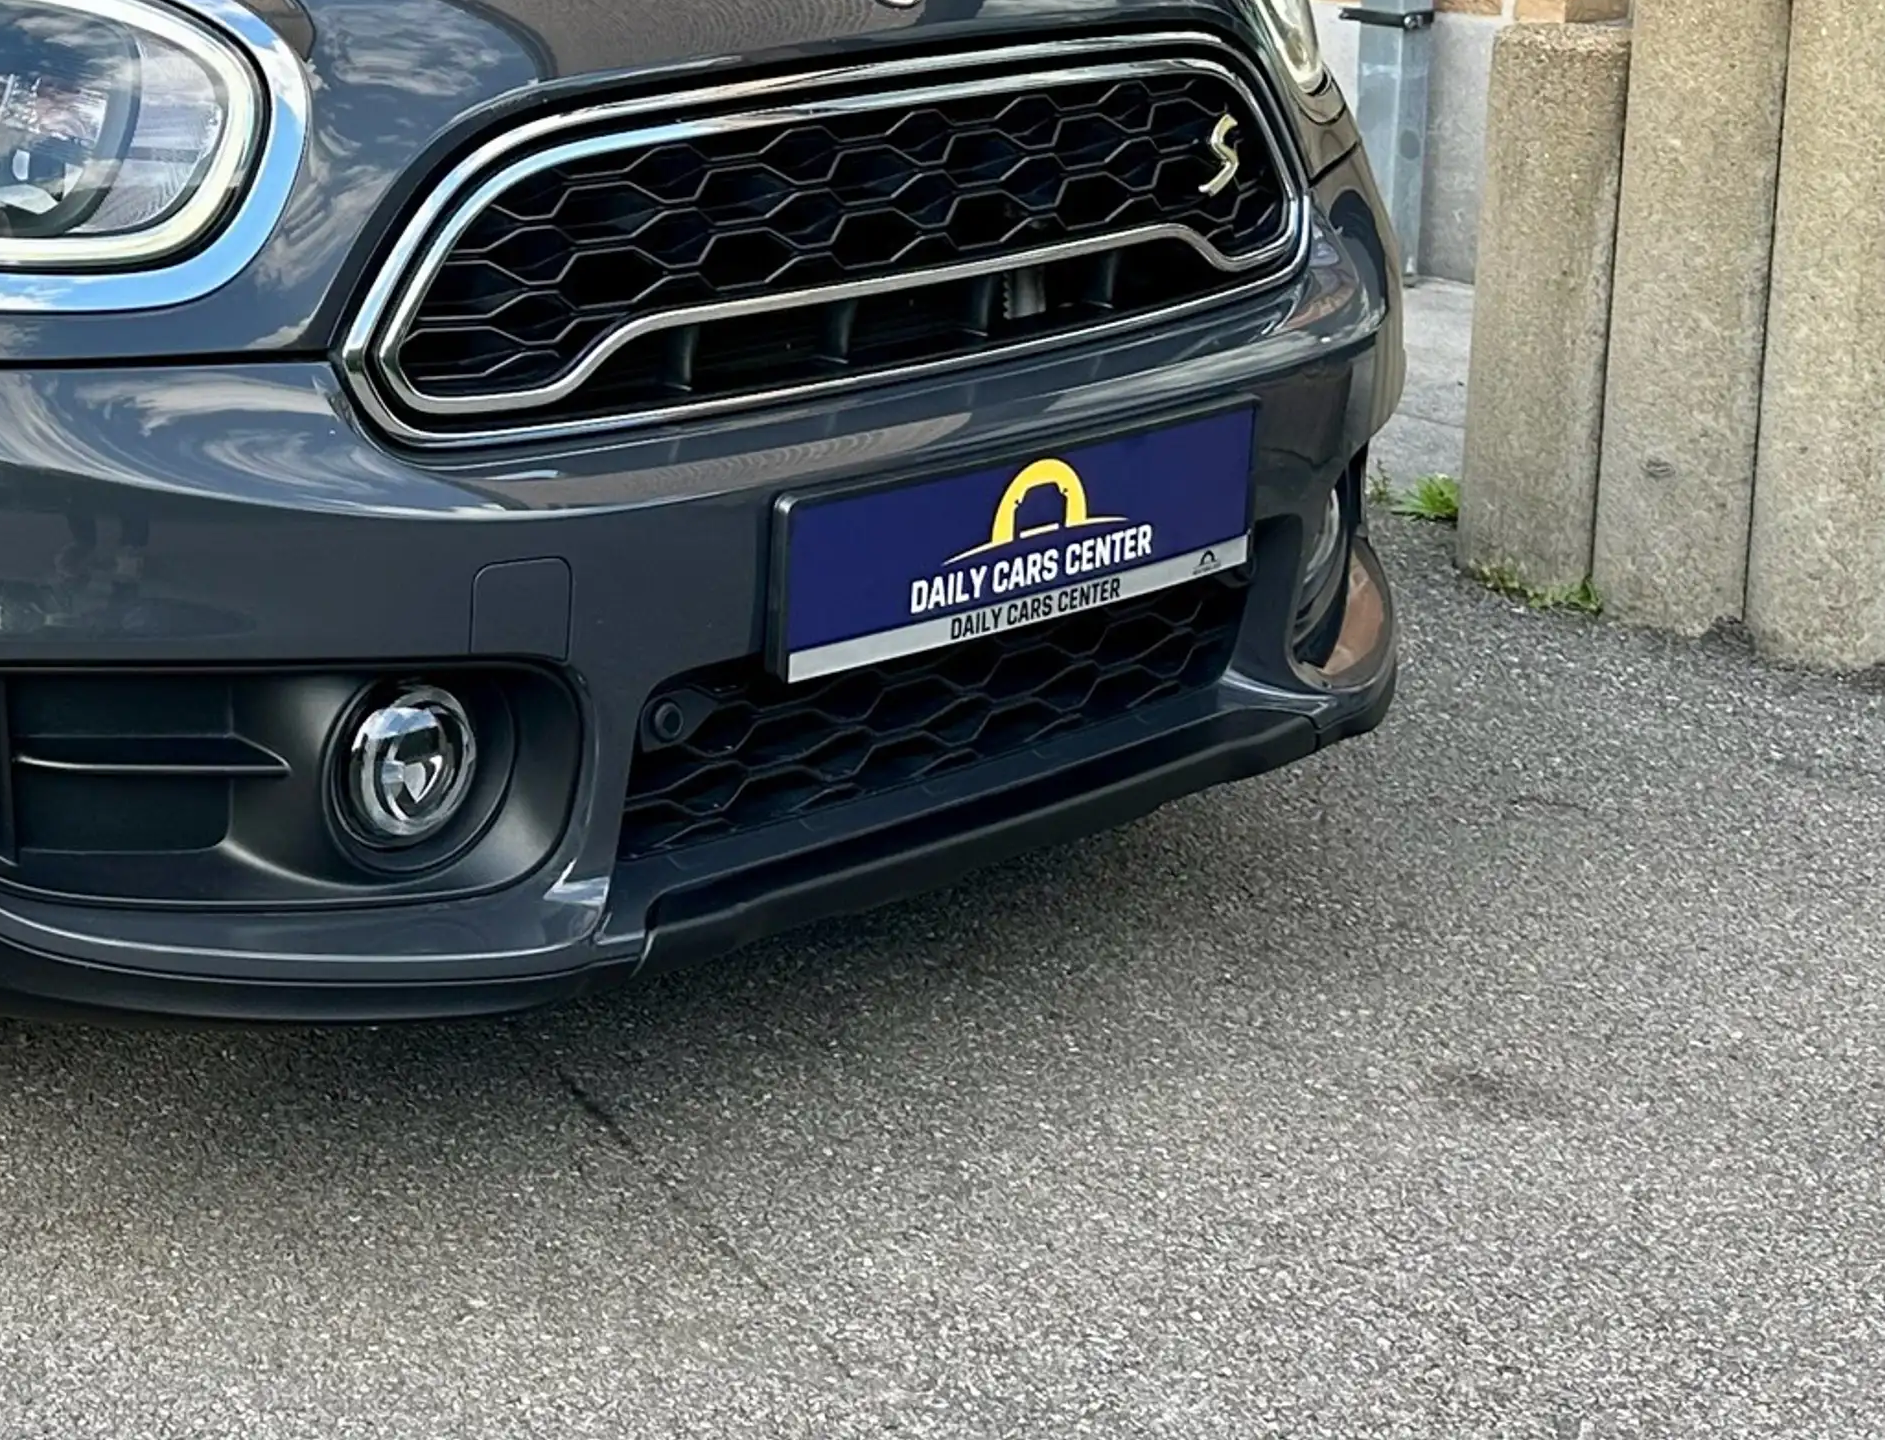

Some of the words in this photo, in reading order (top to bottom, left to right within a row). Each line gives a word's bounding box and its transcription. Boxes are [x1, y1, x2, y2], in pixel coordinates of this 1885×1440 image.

[1198, 113, 1240, 198] S
[910, 565, 988, 614] DAILY
[992, 549, 1059, 593] CARS
[1065, 524, 1152, 574] CENTER
[950, 606, 1003, 641] DAILY
[1006, 594, 1053, 626] CARS
[1057, 577, 1121, 613] CENTER
